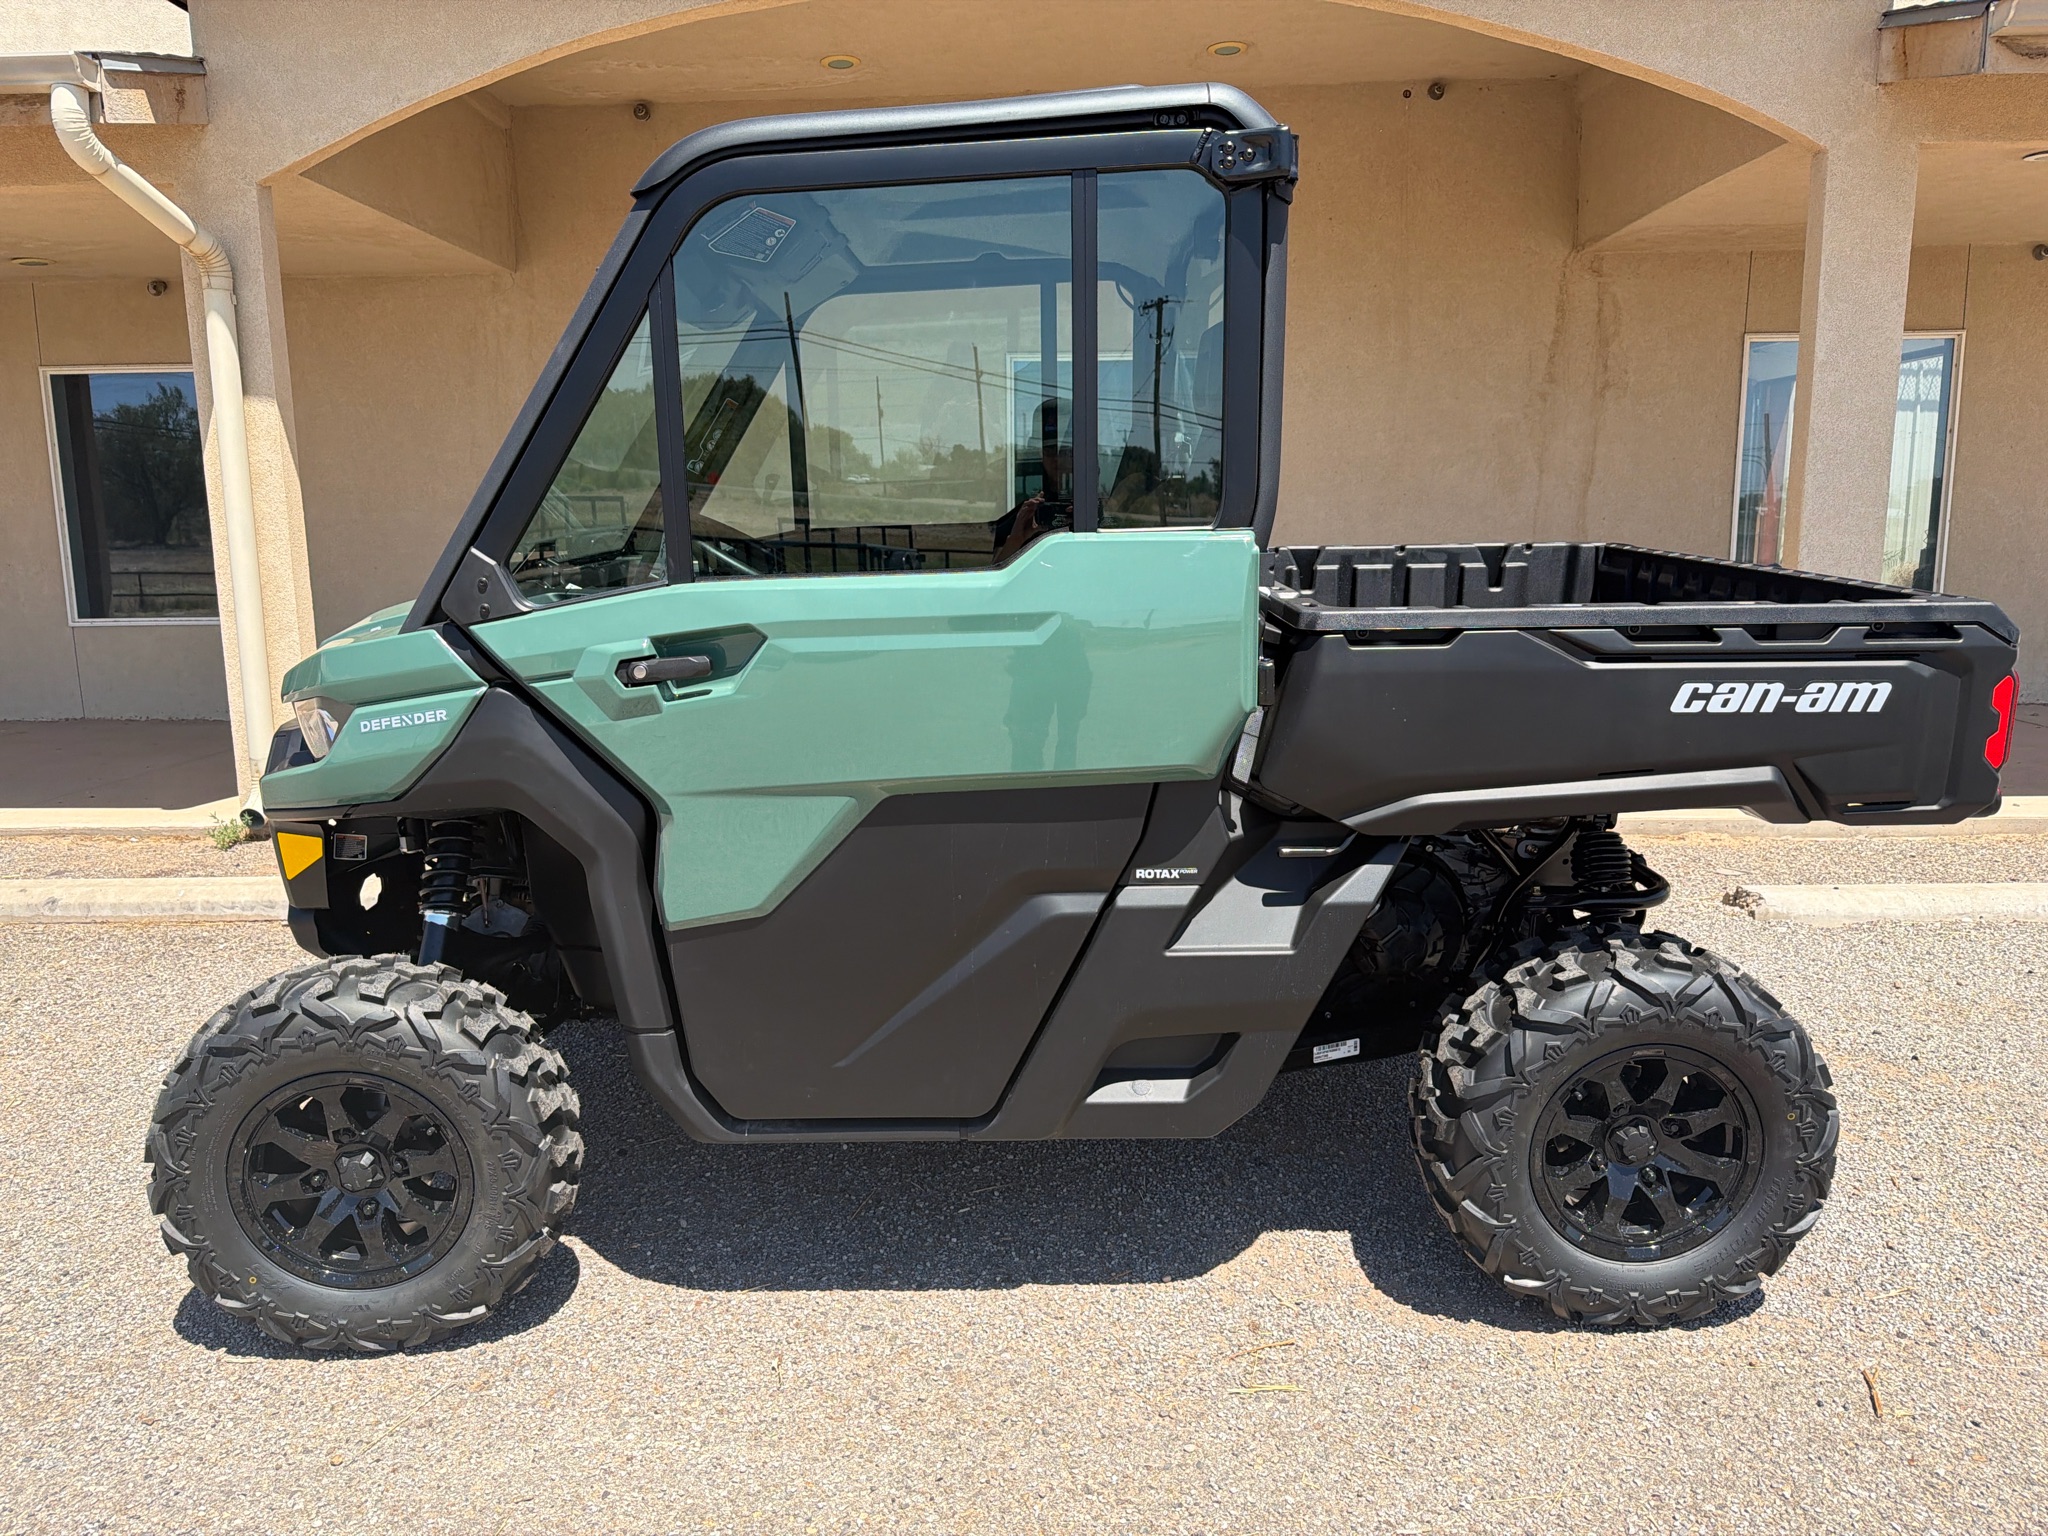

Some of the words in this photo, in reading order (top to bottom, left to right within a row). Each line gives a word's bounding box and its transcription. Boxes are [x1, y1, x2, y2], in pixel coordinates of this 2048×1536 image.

[1670, 682, 1893, 713] can-am
[360, 709, 447, 733] DEFENDER
[1135, 869, 1180, 879] ROTAX
